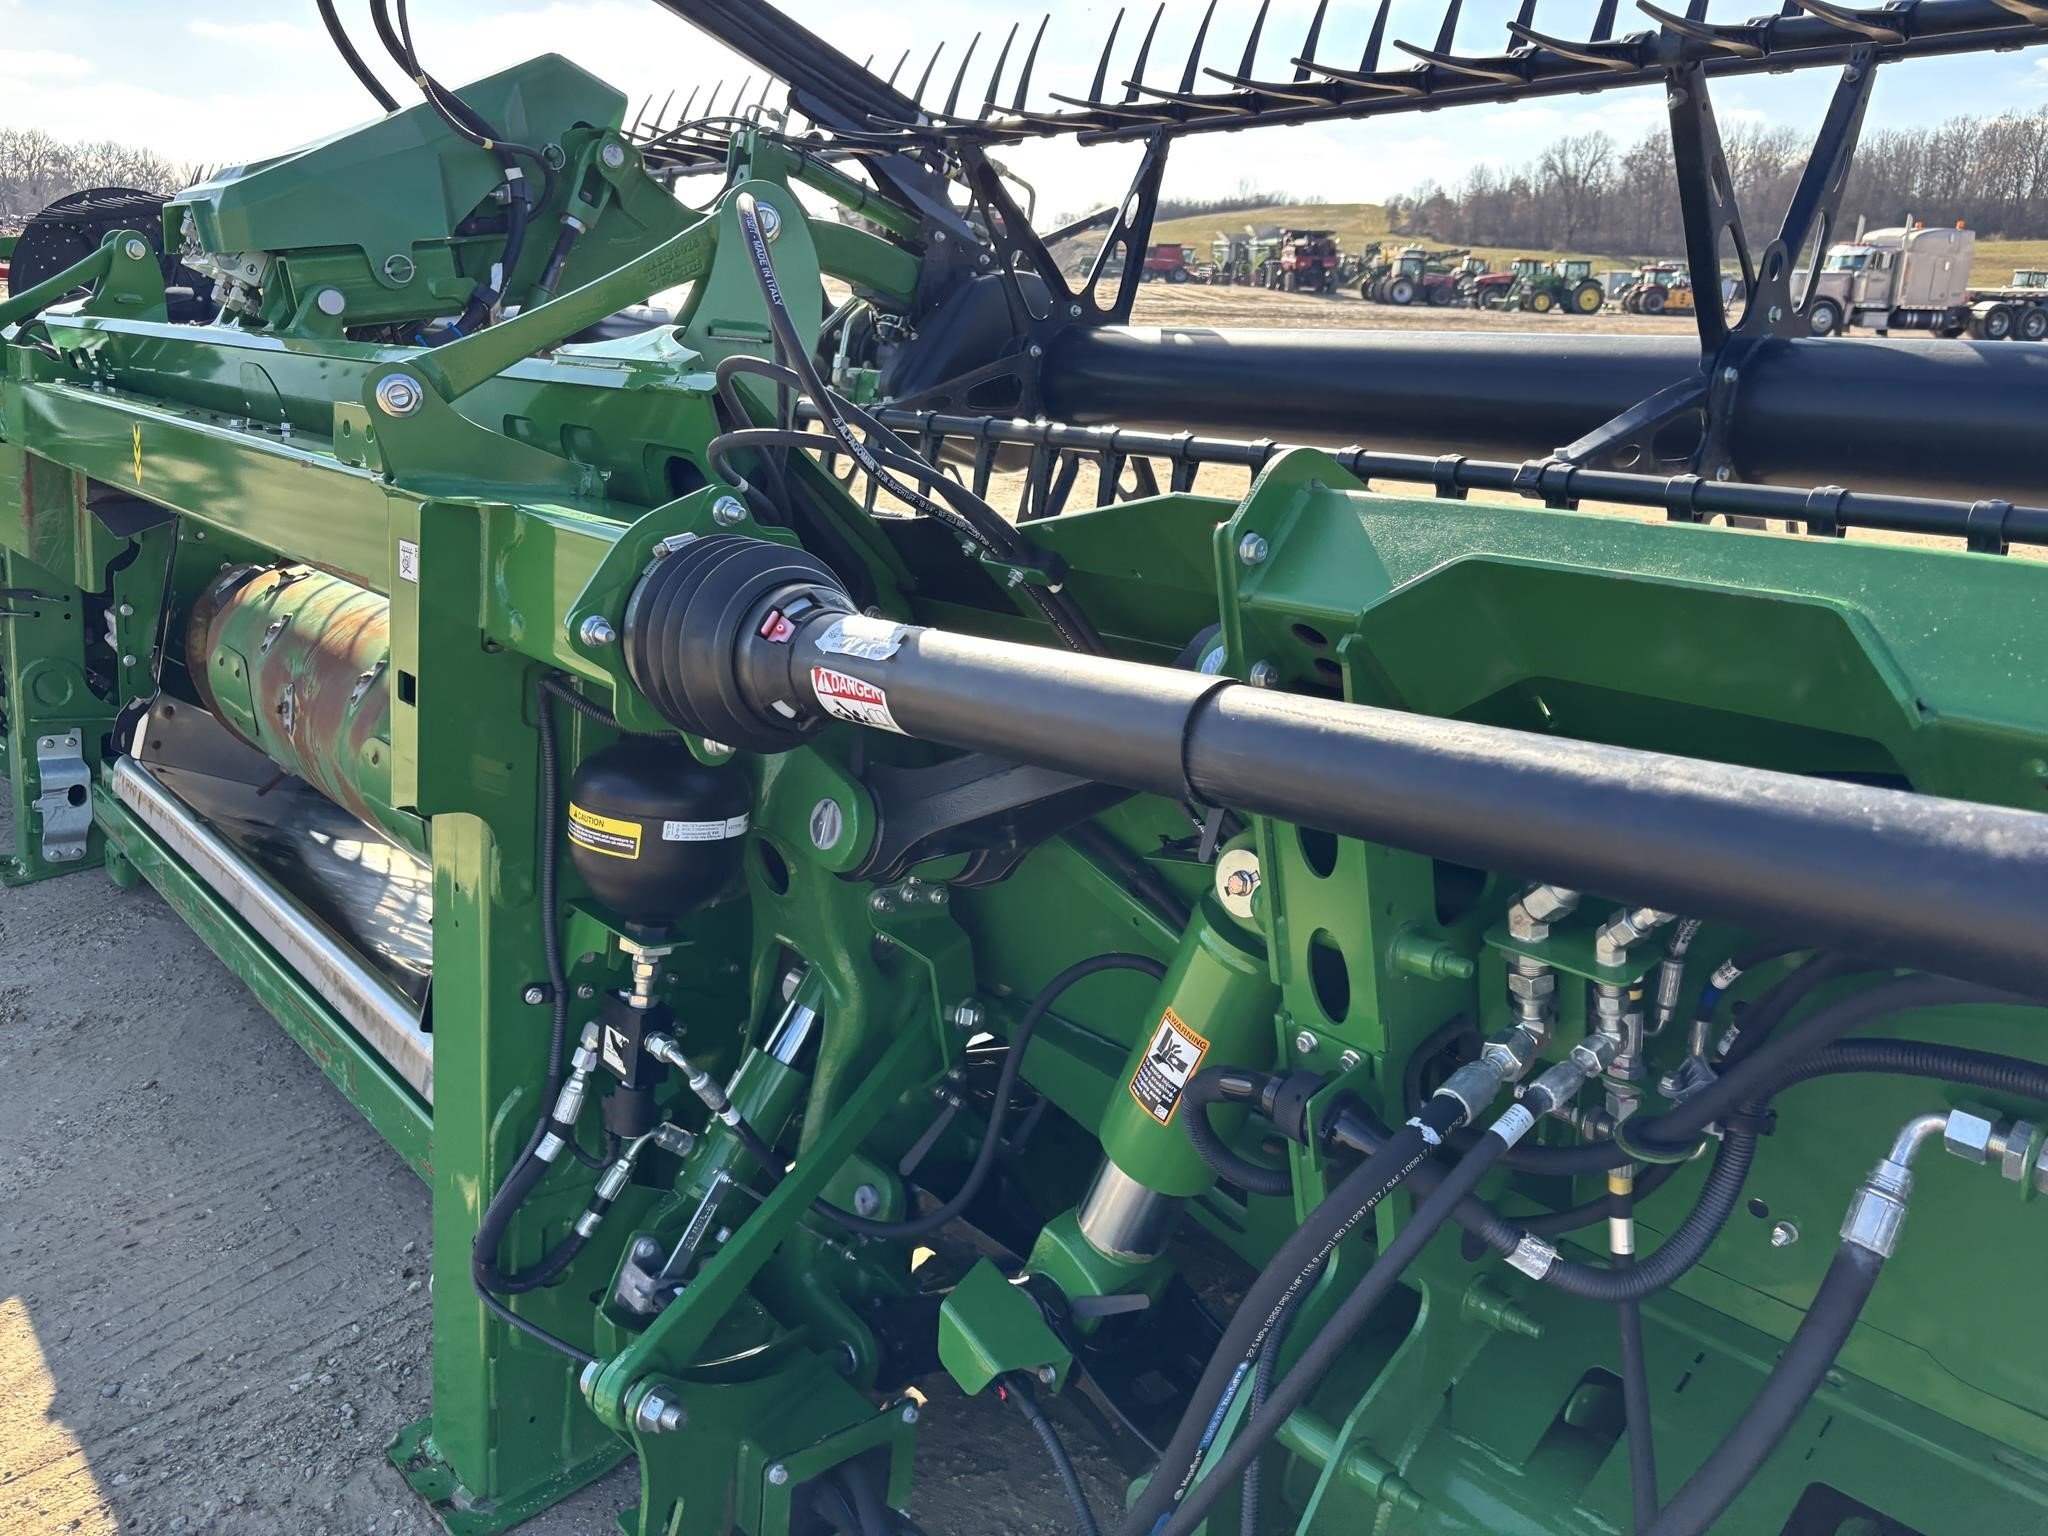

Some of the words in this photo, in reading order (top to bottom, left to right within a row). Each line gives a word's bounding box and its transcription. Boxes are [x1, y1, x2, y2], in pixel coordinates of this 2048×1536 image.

[753, 240, 768, 265] MADE
[762, 267, 772, 278] IN
[766, 279, 783, 306] ITALY
[838, 425, 875, 471] ALFAGOMMA
[830, 674, 882, 700] DANGER
[578, 812, 605, 828] CAUTION
[1172, 1015, 1208, 1050] WARNING
[1162, 1078, 1178, 1092] injury
[1256, 1327, 1268, 1343] MPa
[1278, 1291, 1294, 1306] PSI)
[1333, 1228, 1346, 1242] ISO
[1345, 1205, 1368, 1230] 11237
[1367, 1191, 1382, 1208] R17
[1386, 1174, 1400, 1188] SAE
